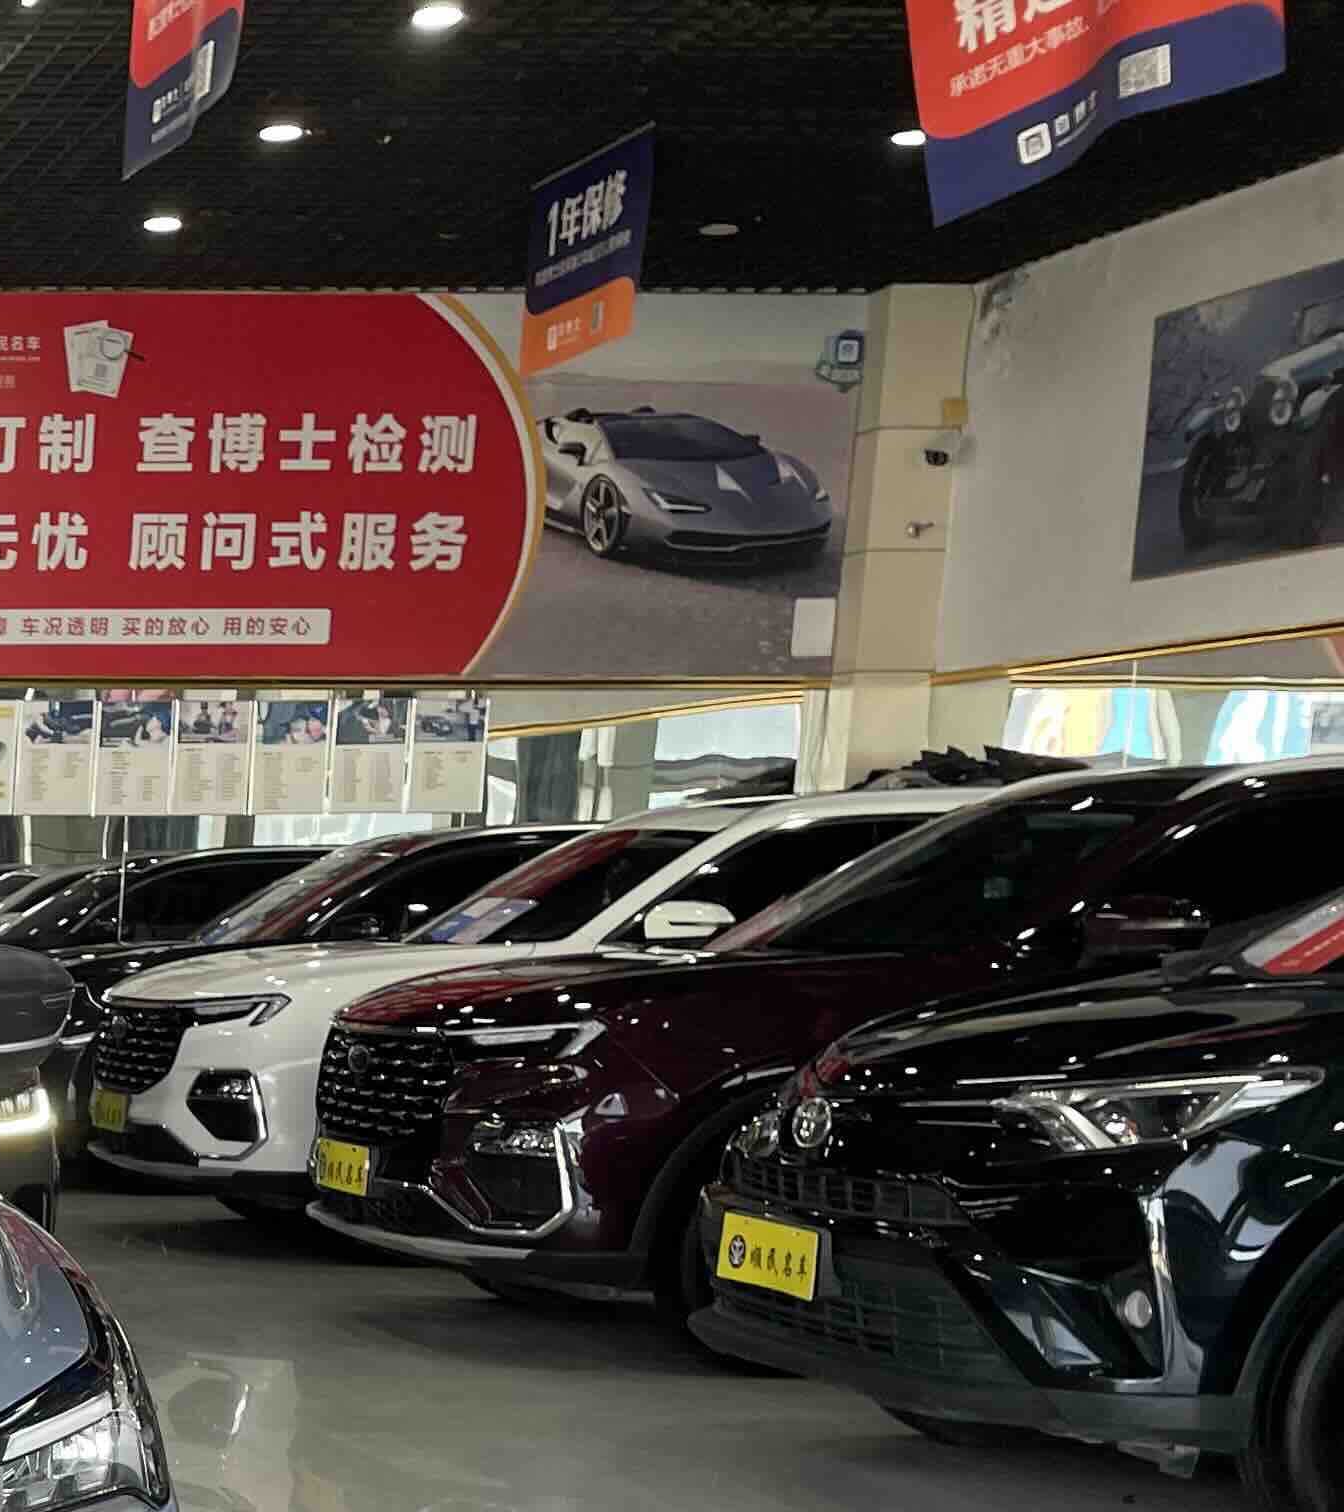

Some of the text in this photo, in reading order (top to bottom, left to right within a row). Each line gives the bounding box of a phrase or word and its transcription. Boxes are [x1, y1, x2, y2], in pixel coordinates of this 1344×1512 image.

[546, 168, 628, 257] 1年保修
[136, 413, 478, 474] 查博士检测
[128, 511, 468, 572] 顾问式服务
[19, 616, 110, 638] 车况透明
[120, 616, 212, 638] 买的放心
[222, 616, 313, 638] 用的安心
